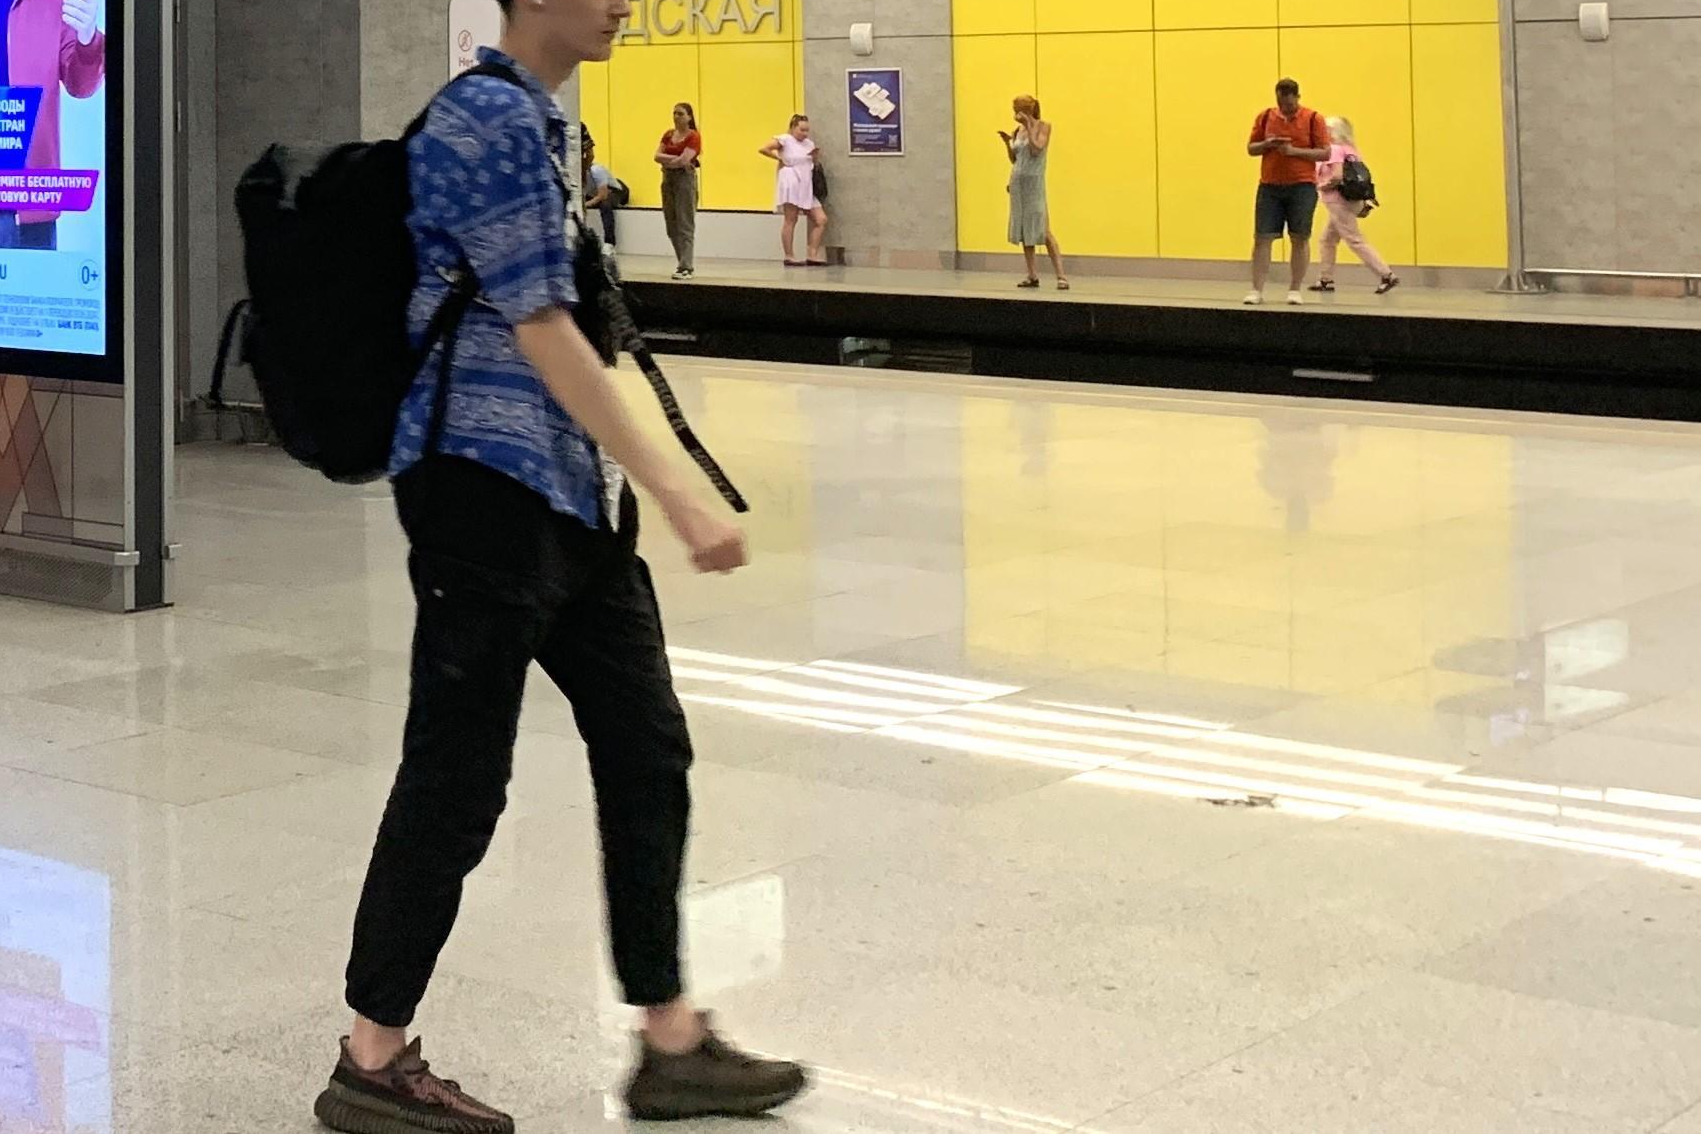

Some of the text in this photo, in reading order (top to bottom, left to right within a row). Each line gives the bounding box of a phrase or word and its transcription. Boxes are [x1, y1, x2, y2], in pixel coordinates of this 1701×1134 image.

[27, 176, 92, 189] БЕСПЛАТНУЮ
[30, 191, 63, 204] КАРТУ
[81, 265, 99, 285] 0+
